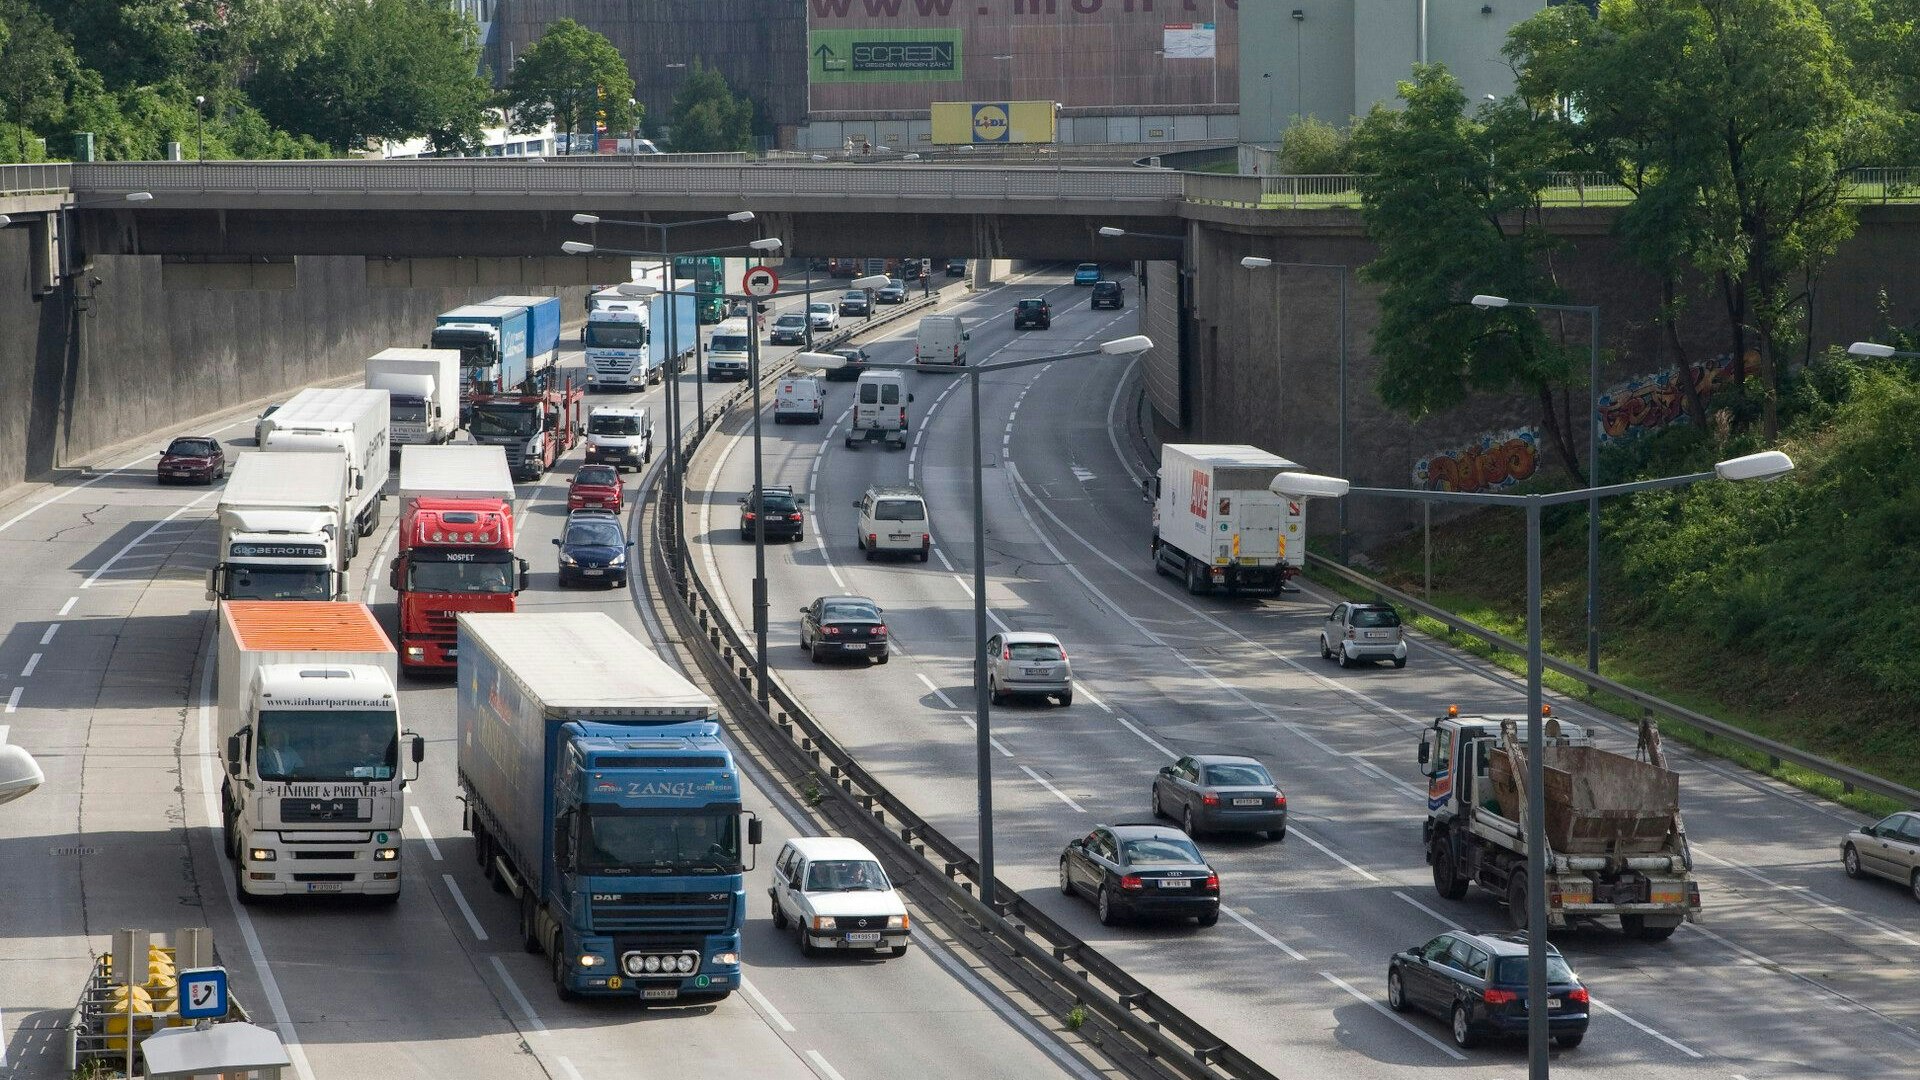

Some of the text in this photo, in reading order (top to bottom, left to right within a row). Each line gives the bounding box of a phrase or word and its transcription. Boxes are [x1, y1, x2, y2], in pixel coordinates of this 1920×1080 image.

[855, 46, 952, 61] SCREEN
[233, 545, 323, 556] GLOBETROTTER
[333, 785, 377, 797] PARTNER
